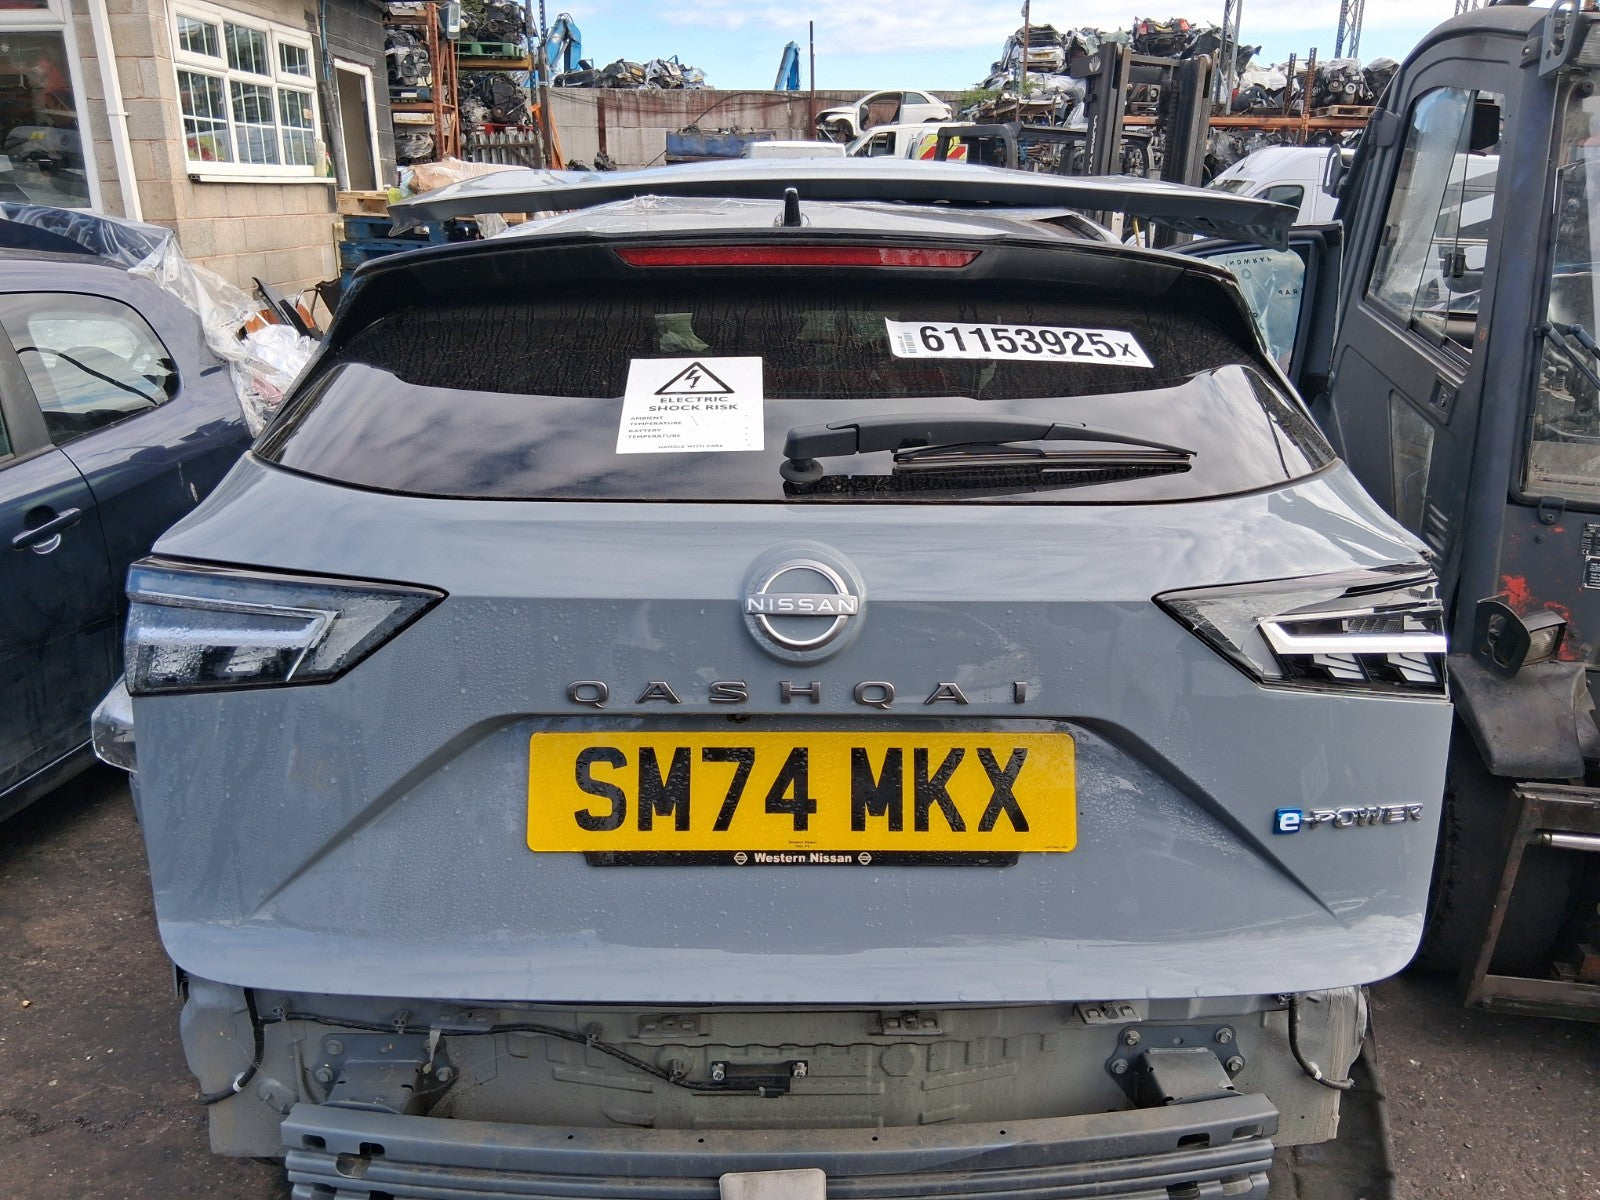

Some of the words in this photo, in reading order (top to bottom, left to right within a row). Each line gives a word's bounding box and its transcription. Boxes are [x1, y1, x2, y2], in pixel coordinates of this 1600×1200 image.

[648, 404, 701, 412] SHOCK
[747, 598, 855, 613] NISSAN
[566, 680, 1028, 709] QASHQAI
[574, 746, 817, 832] SM74
[850, 747, 1030, 833] MKX
[1275, 803, 1424, 832] e-POWER
[754, 852, 804, 864] Western
[809, 852, 852, 863] Nissan
